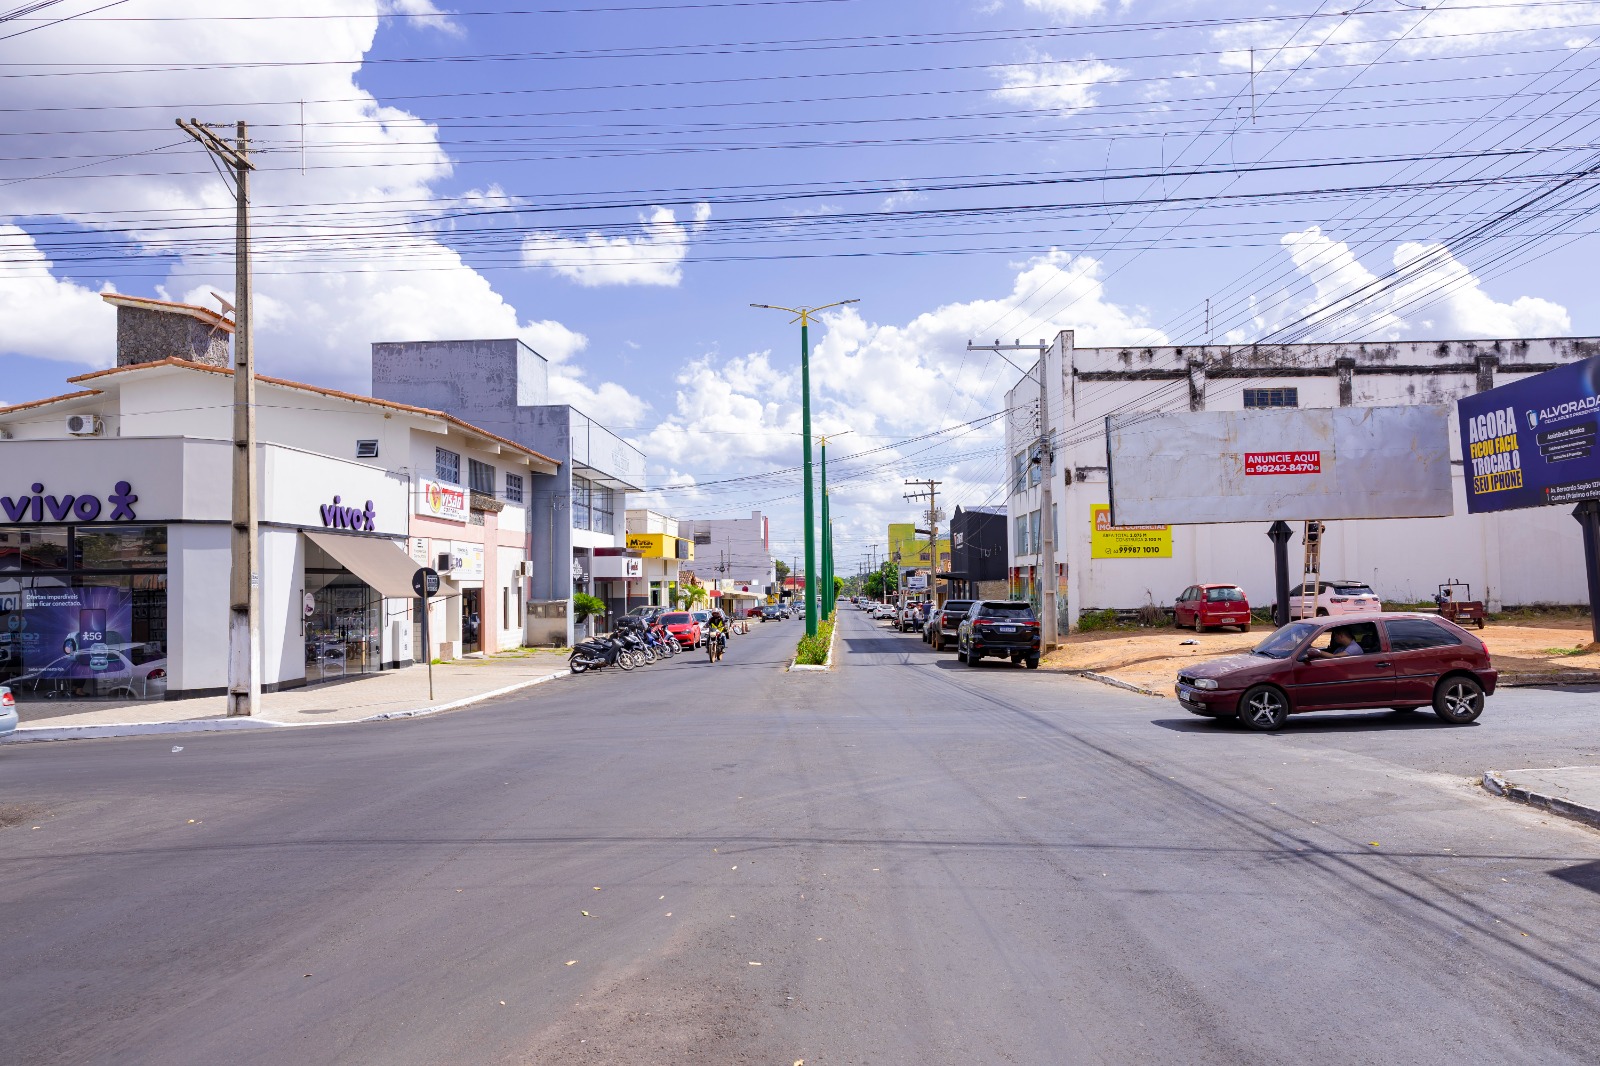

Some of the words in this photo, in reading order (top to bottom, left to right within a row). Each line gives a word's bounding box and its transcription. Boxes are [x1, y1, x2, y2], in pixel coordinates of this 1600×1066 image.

[1540, 395, 1600, 420] ALVORADA
[1469, 406, 1518, 443] AGORA
[1247, 455, 1292, 464] ANUNCIE
[1293, 454, 1318, 463] AQUI
[1470, 439, 1494, 459] FICOU
[1255, 463, 1314, 472] 99242-8470
[1472, 452, 1511, 476] TROCAR
[1512, 450, 1521, 470] O
[1474, 476, 1489, 492] SEU
[1491, 470, 1522, 490] IPHONE
[0, 482, 102, 522] vivo
[319, 495, 363, 530] vivo
[47, 593, 79, 601] imperdíveis
[89, 632, 102, 641] 5G
